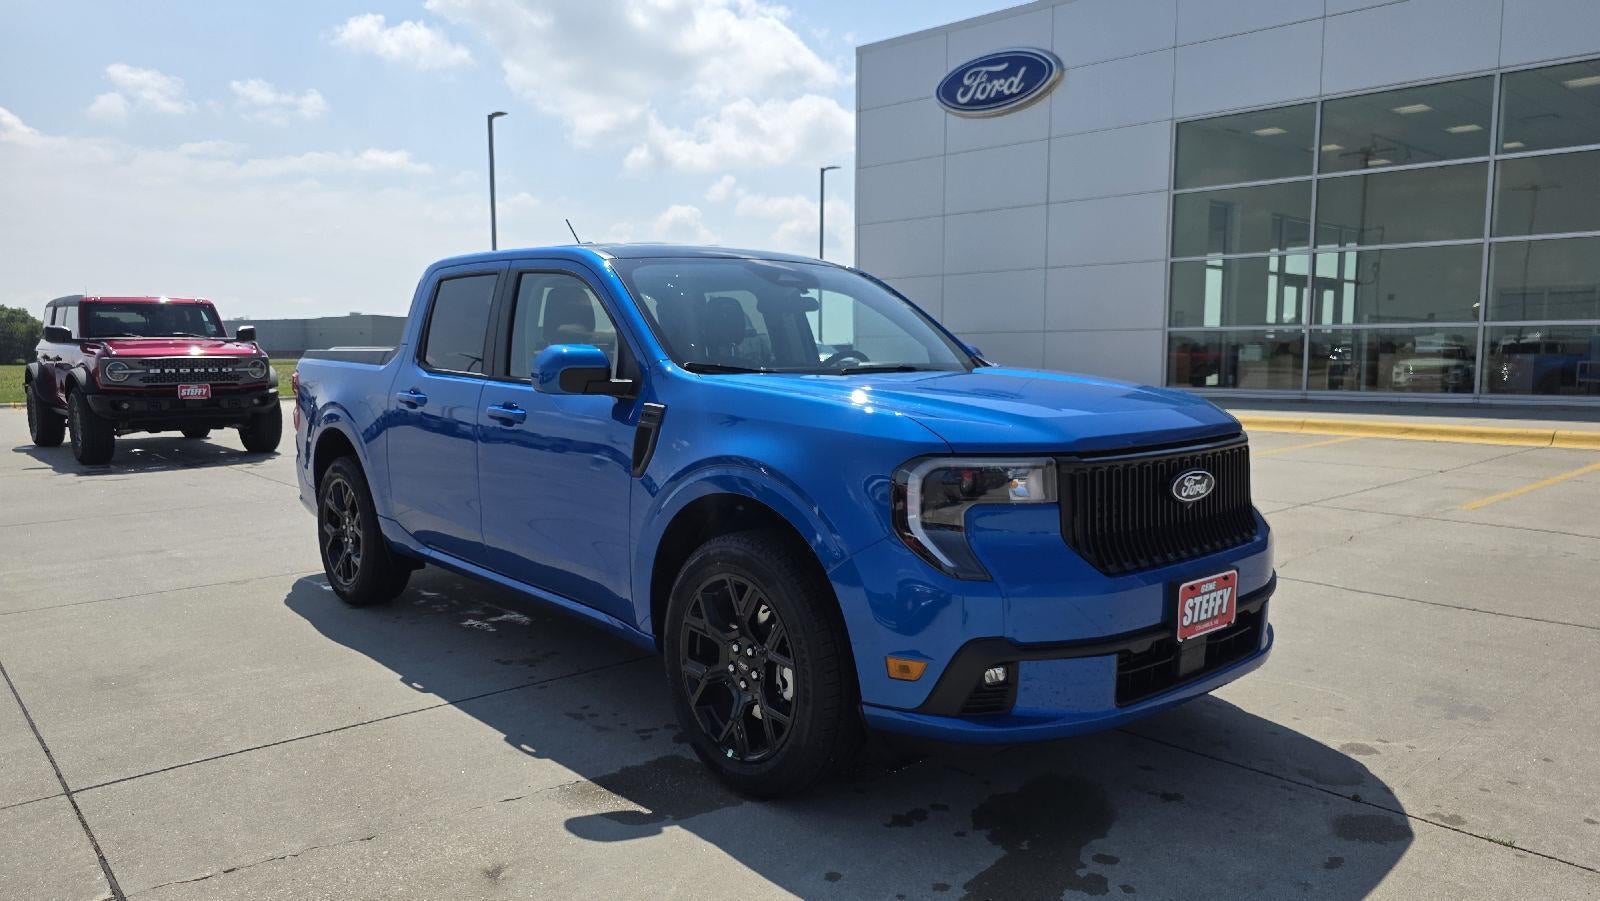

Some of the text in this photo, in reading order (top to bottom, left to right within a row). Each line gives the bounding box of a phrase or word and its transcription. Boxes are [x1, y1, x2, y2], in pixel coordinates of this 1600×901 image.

[957, 62, 1026, 103] Ford
[1181, 475, 1207, 497] Ford
[1182, 587, 1232, 627] STEFFY
